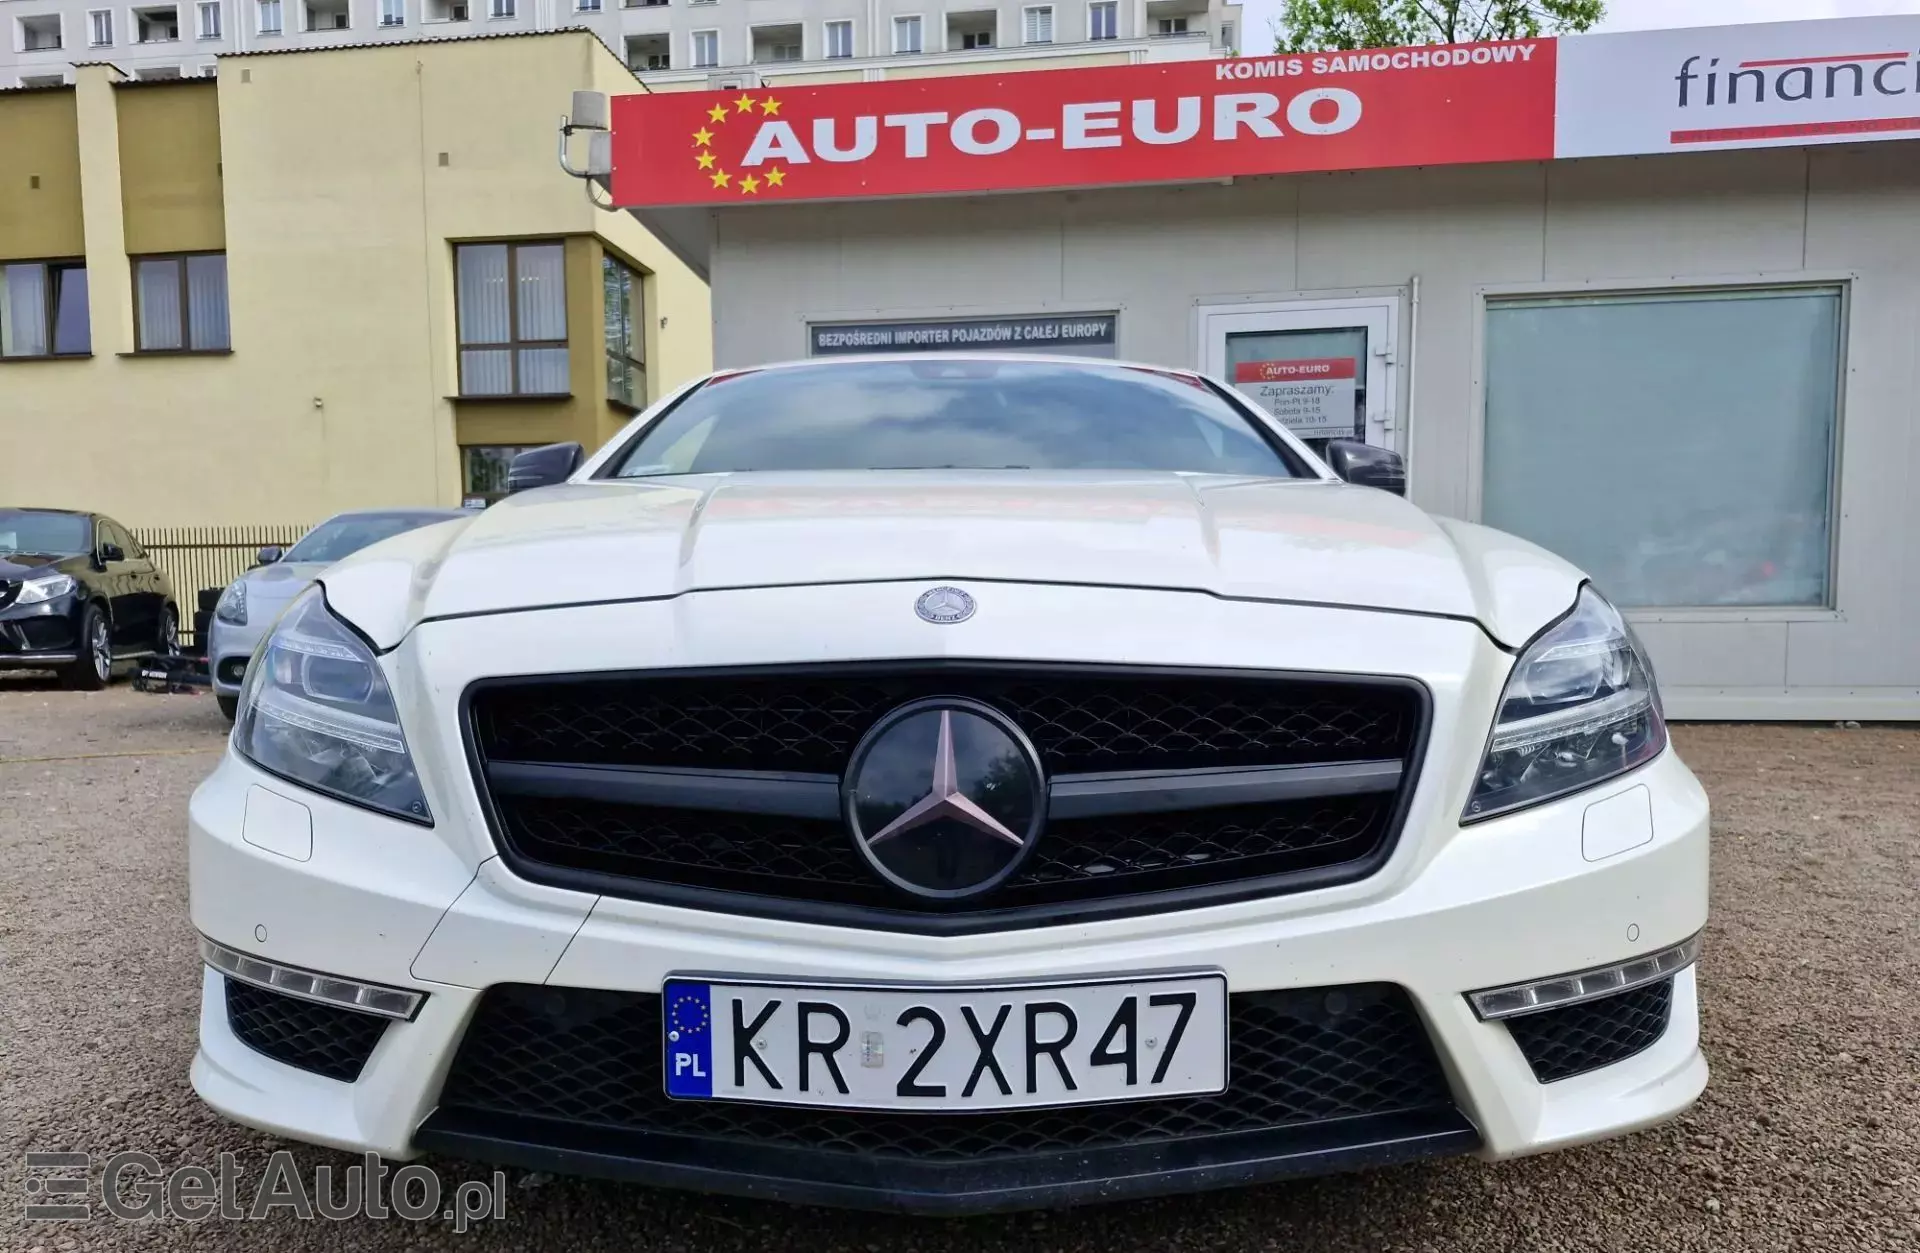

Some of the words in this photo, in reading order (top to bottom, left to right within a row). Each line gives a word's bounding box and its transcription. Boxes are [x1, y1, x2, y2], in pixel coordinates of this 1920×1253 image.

[1215, 58, 1302, 80] KOMIS
[1312, 44, 1537, 75] SAMOCHODOWY
[740, 87, 1363, 167] AUTO-EURO
[818, 330, 892, 347] BEZPOŚREDNI
[894, 330, 949, 345] IMPORTER
[951, 324, 1012, 342] POJAZDÓW
[1014, 326, 1023, 340] Z
[1061, 322, 1107, 338] EUROPY
[1266, 365, 1330, 375] AUTO-EURO
[1260, 384, 1335, 397] Zapraszamy:
[732, 998, 851, 1094] KR
[896, 992, 1196, 1097] 2XR47
[675, 1052, 706, 1077] PL
